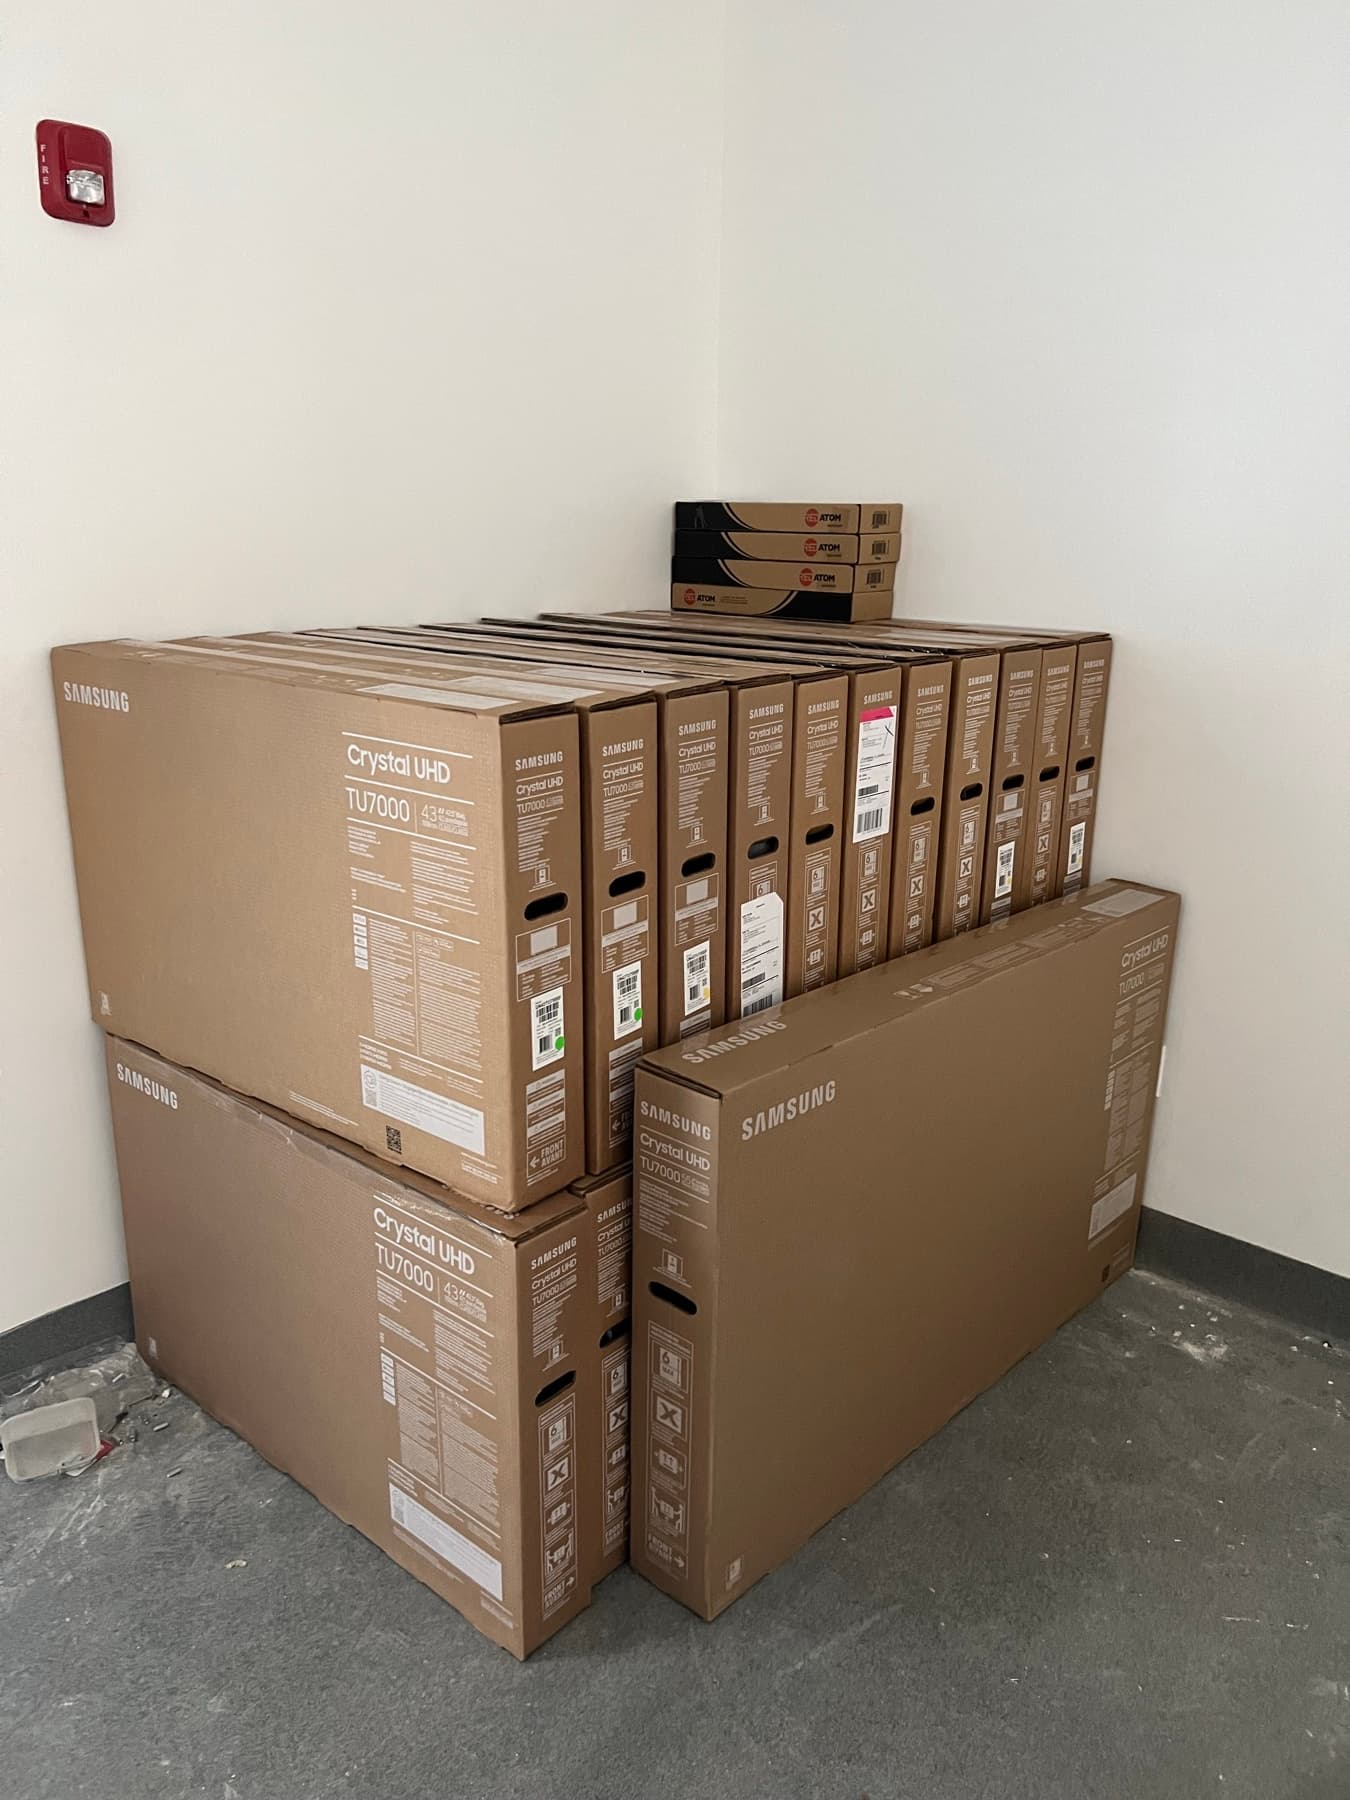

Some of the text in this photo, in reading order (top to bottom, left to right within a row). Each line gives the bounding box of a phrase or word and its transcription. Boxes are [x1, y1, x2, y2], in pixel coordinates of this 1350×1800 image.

[40, 144, 50, 185] FIRE
[819, 513, 842, 522] ATOM
[818, 543, 841, 552] ATOM
[813, 573, 836, 583] ATOM
[63, 681, 130, 713] SAMSUNG
[807, 699, 840, 715] SAMSUNG
[749, 703, 785, 719] SAMSUNG
[678, 719, 717, 737] SAMSUNG
[749, 724, 784, 741] Crystal UHD
[602, 738, 644, 757] SAMSUNG
[678, 742, 717, 758] Crystal UHD
[346, 744, 451, 784] Crystal UHD
[515, 751, 563, 771] SAMSUNG
[602, 762, 644, 780] Crystal UHD
[516, 776, 564, 796] Crystal UHD
[603, 783, 628, 797] TU7000
[345, 787, 411, 822] TU7000
[516, 799, 546, 815] TU7000
[1121, 934, 1169, 968] Crystal UHD
[682, 1020, 787, 1064] SAMSUNG
[117, 1063, 178, 1110] SAMSUNG
[640, 1100, 711, 1141] SAMSUNG
[742, 1080, 836, 1141] SAMSUNG
[541, 1140, 563, 1158] FRONT
[541, 1149, 563, 1168] AVANT
[640, 1132, 711, 1171] Crystal UHD
[640, 1155, 681, 1184] TU7000
[373, 1207, 475, 1275] Crystal UHD
[598, 1220, 624, 1242] Crystal
[530, 1236, 577, 1270] SAMSUNG
[374, 1242, 434, 1292] TU7000
[531, 1258, 577, 1290] Crystal UHD
[532, 1285, 560, 1306] TU7000
[662, 1351, 670, 1364] 6
